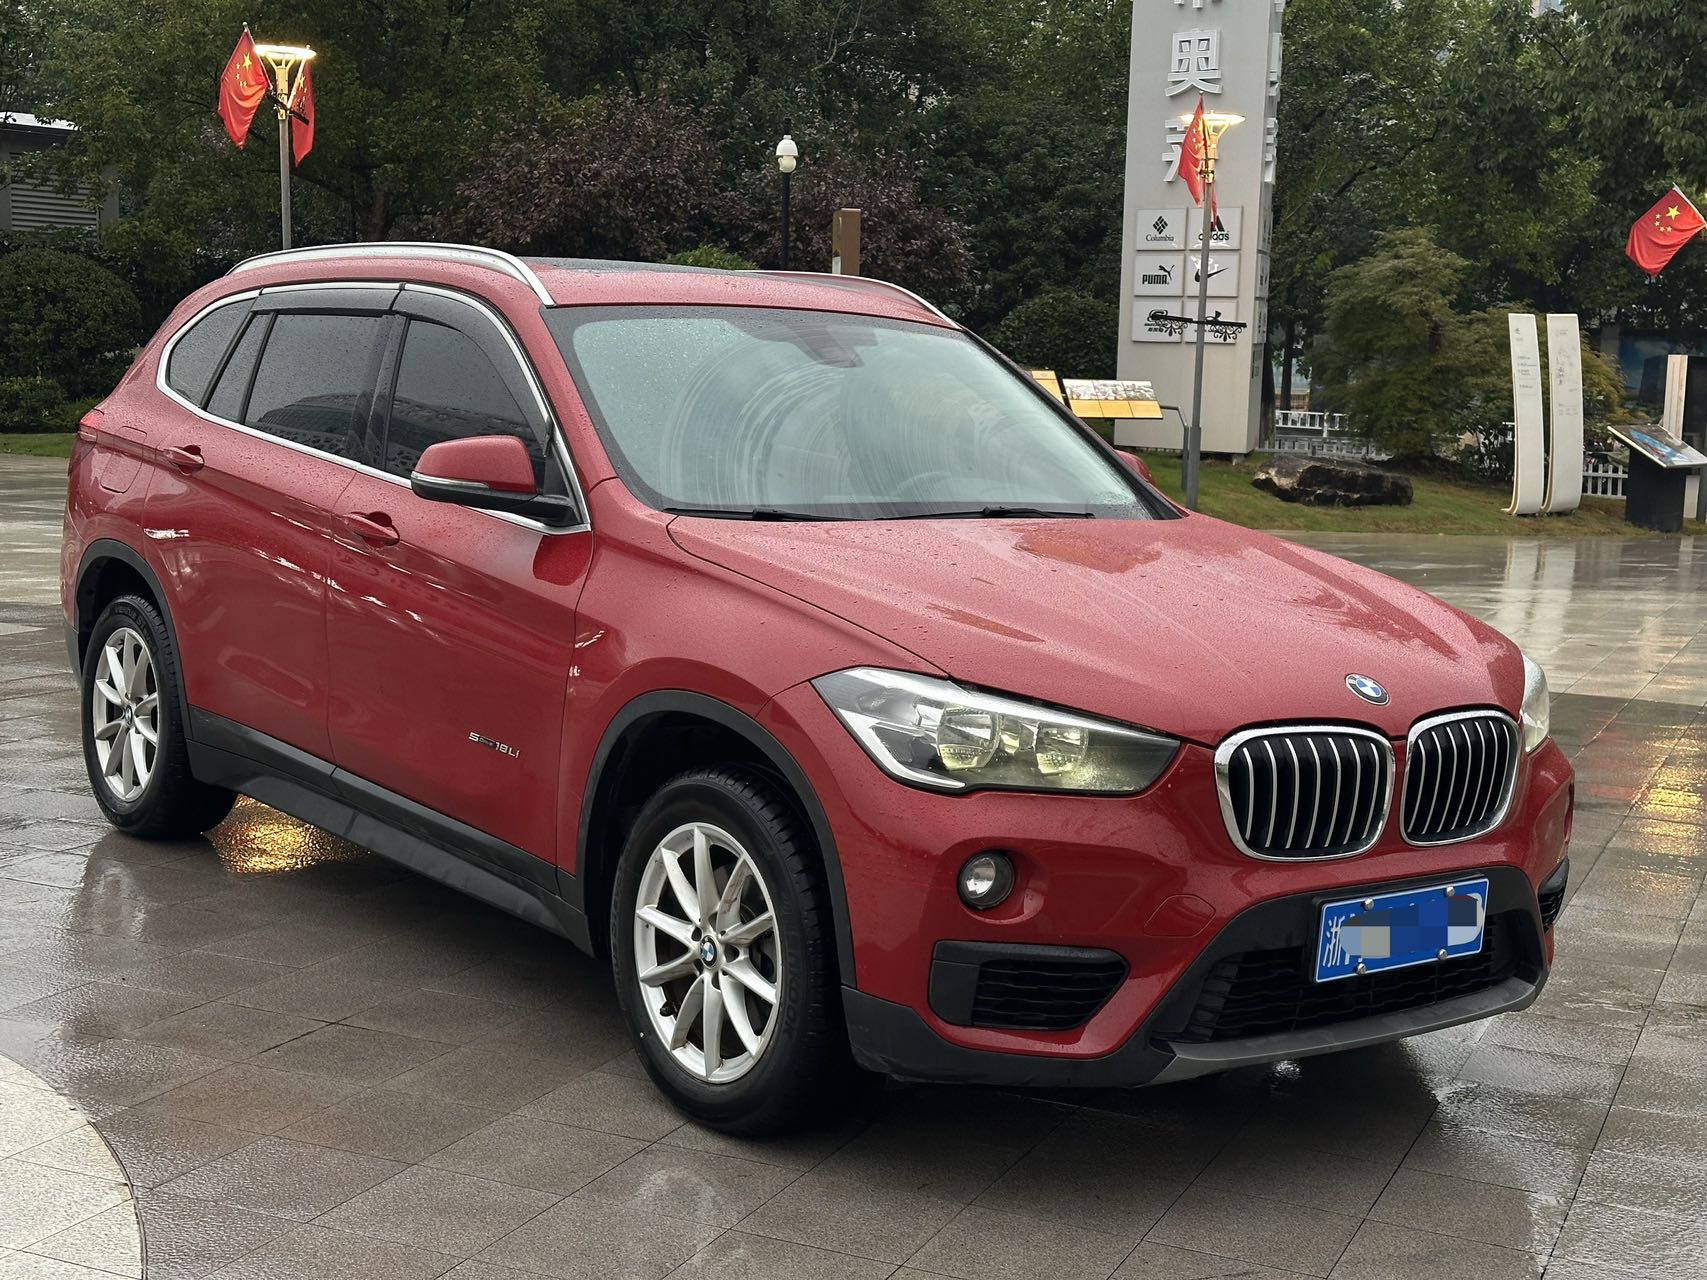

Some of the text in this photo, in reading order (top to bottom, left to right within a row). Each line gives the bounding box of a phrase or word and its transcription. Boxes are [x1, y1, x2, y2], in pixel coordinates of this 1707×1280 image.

[1145, 233, 1174, 242] Columbia
[1198, 231, 1230, 241] adas
[1142, 274, 1168, 285] PUMA
